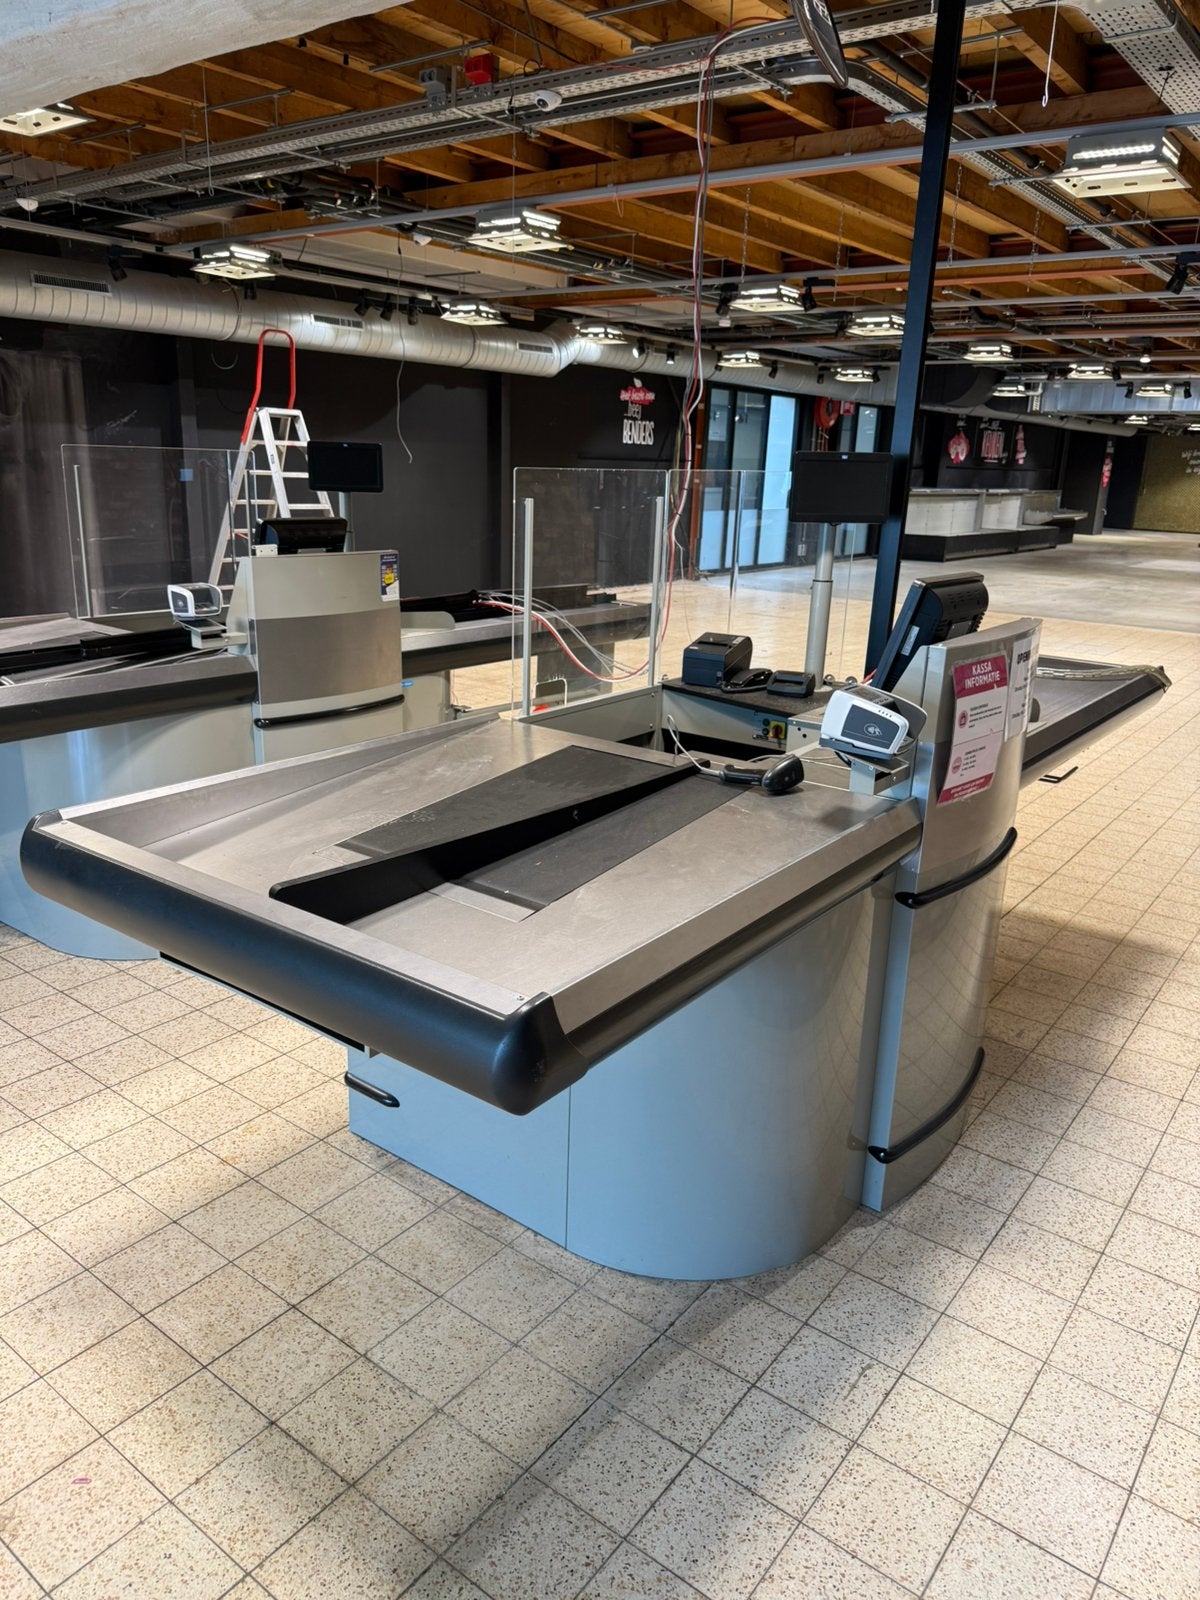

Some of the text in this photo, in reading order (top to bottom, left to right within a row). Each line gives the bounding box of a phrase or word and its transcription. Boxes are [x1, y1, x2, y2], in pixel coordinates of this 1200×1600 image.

[622, 419, 655, 446] BENDERS
[972, 661, 993, 675] KASSA
[965, 670, 1000, 689] INFORMATIE
